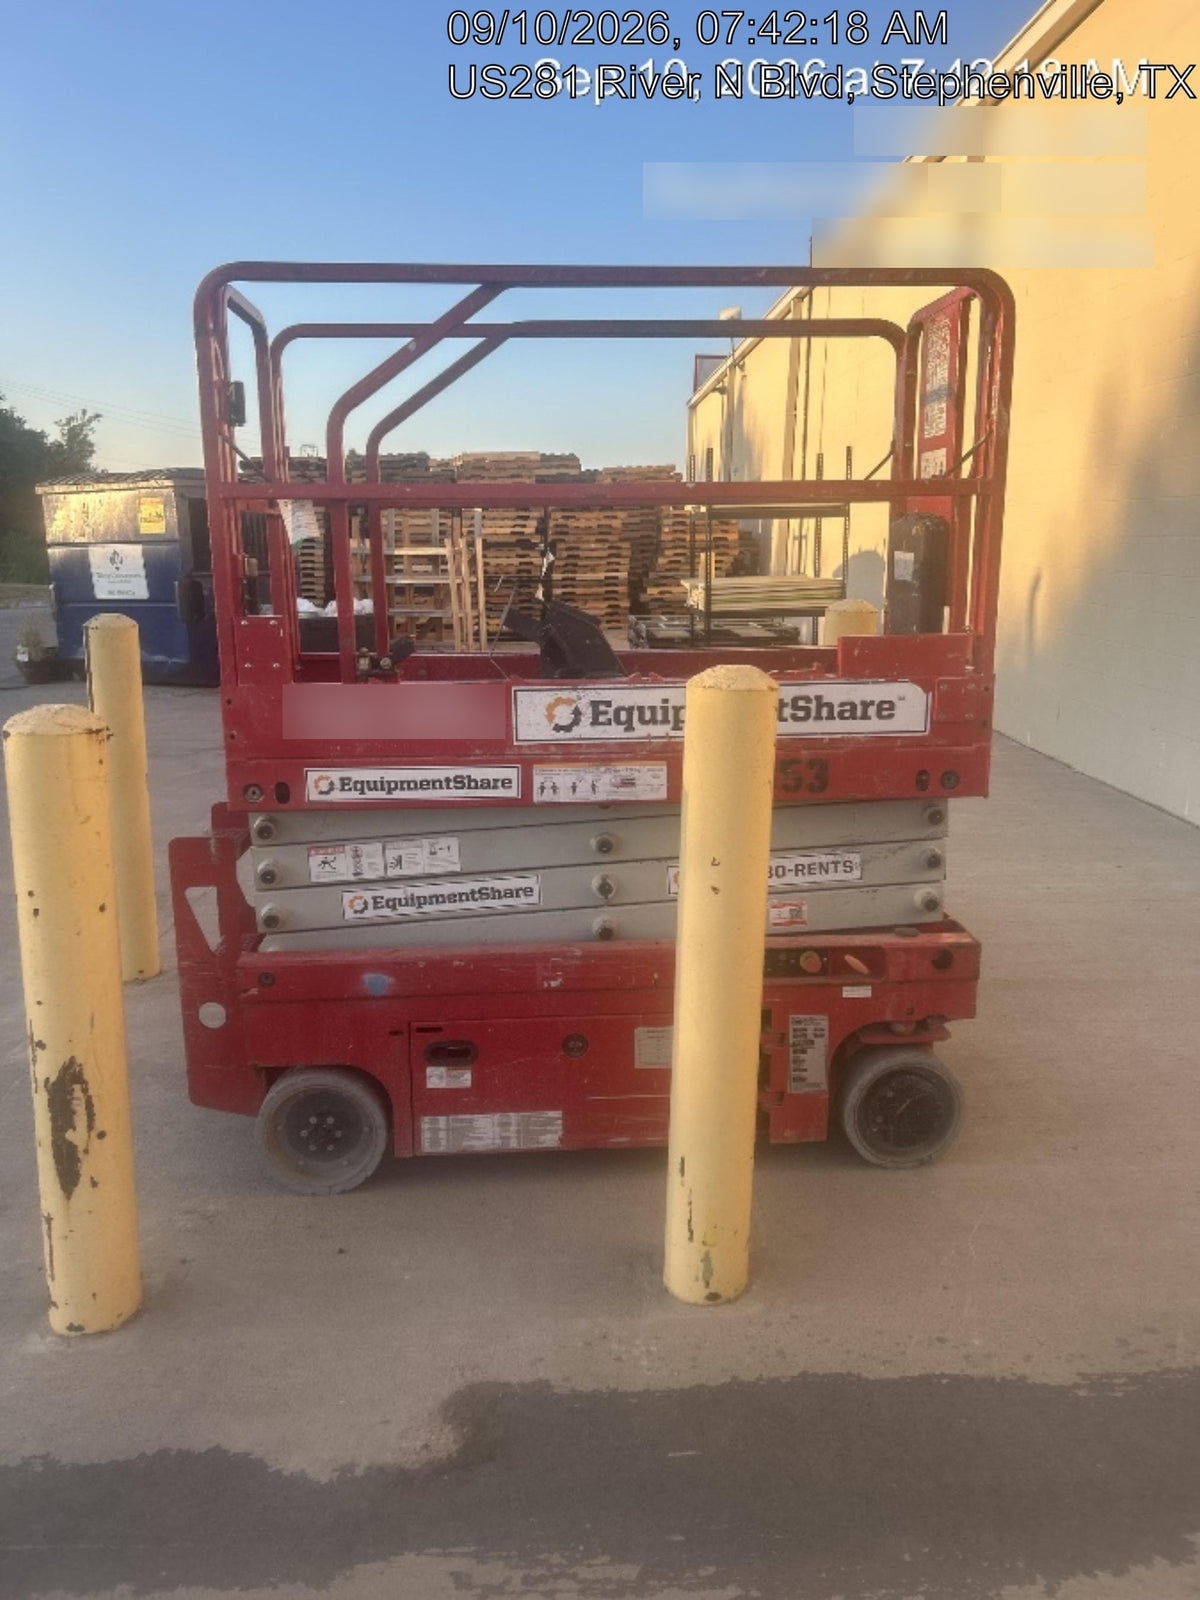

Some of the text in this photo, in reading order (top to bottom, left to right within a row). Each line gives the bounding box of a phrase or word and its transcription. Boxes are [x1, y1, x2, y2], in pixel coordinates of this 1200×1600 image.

[589, 694, 896, 732] EquiptShare
[339, 774, 513, 795] EquipmentShare
[372, 886, 534, 911] EquipmentShare
